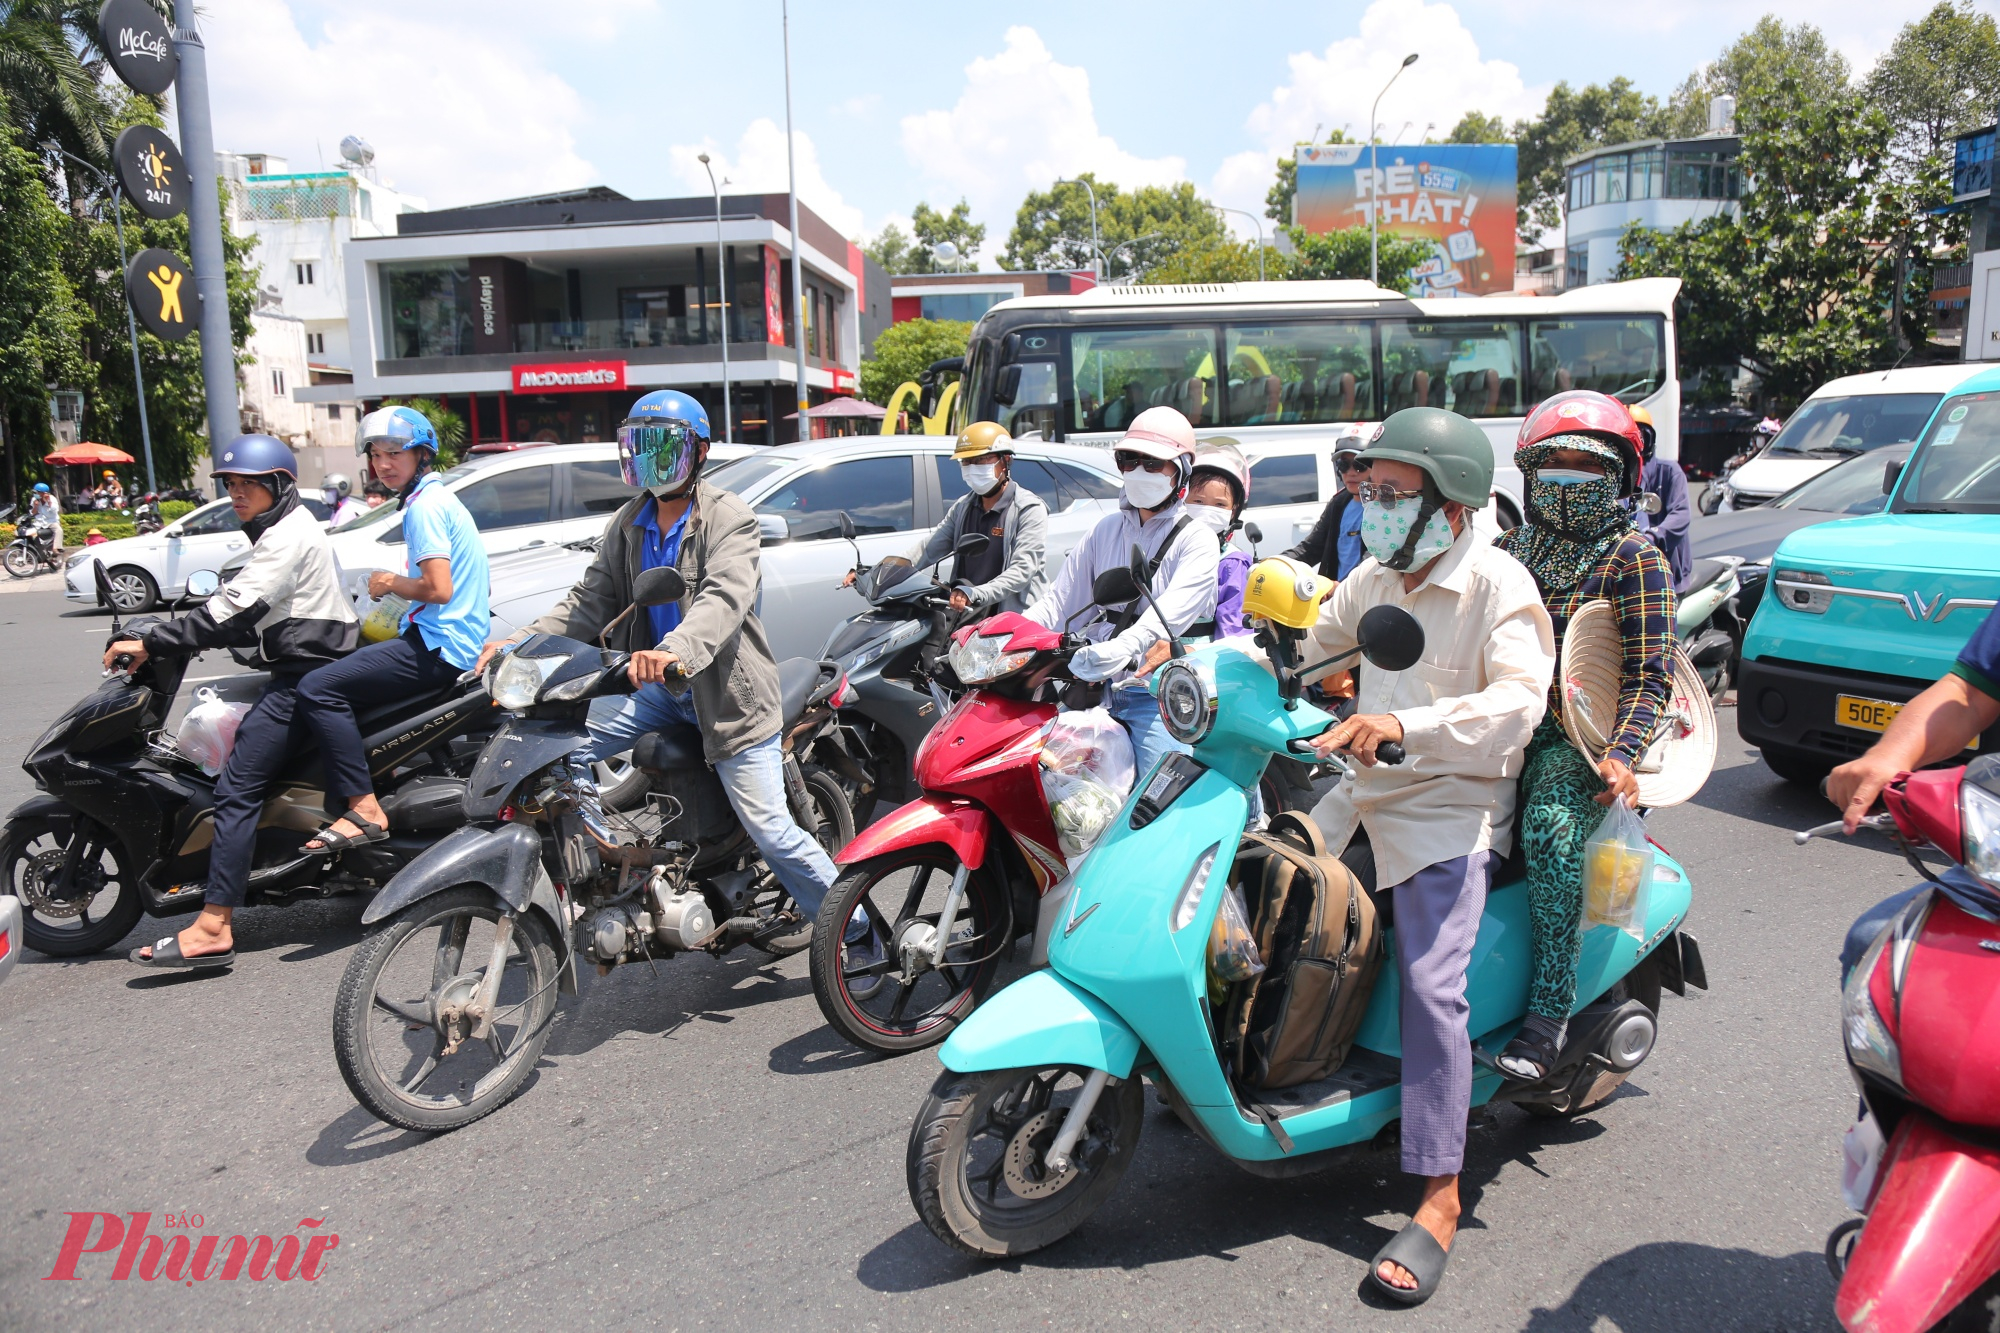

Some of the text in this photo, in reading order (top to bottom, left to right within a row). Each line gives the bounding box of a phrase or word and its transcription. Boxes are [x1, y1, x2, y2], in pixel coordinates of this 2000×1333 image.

[119, 27, 167, 62] McCafé
[145, 188, 172, 205] 24/7
[479, 275, 495, 336] playplace
[519, 369, 617, 387] McDonald's
